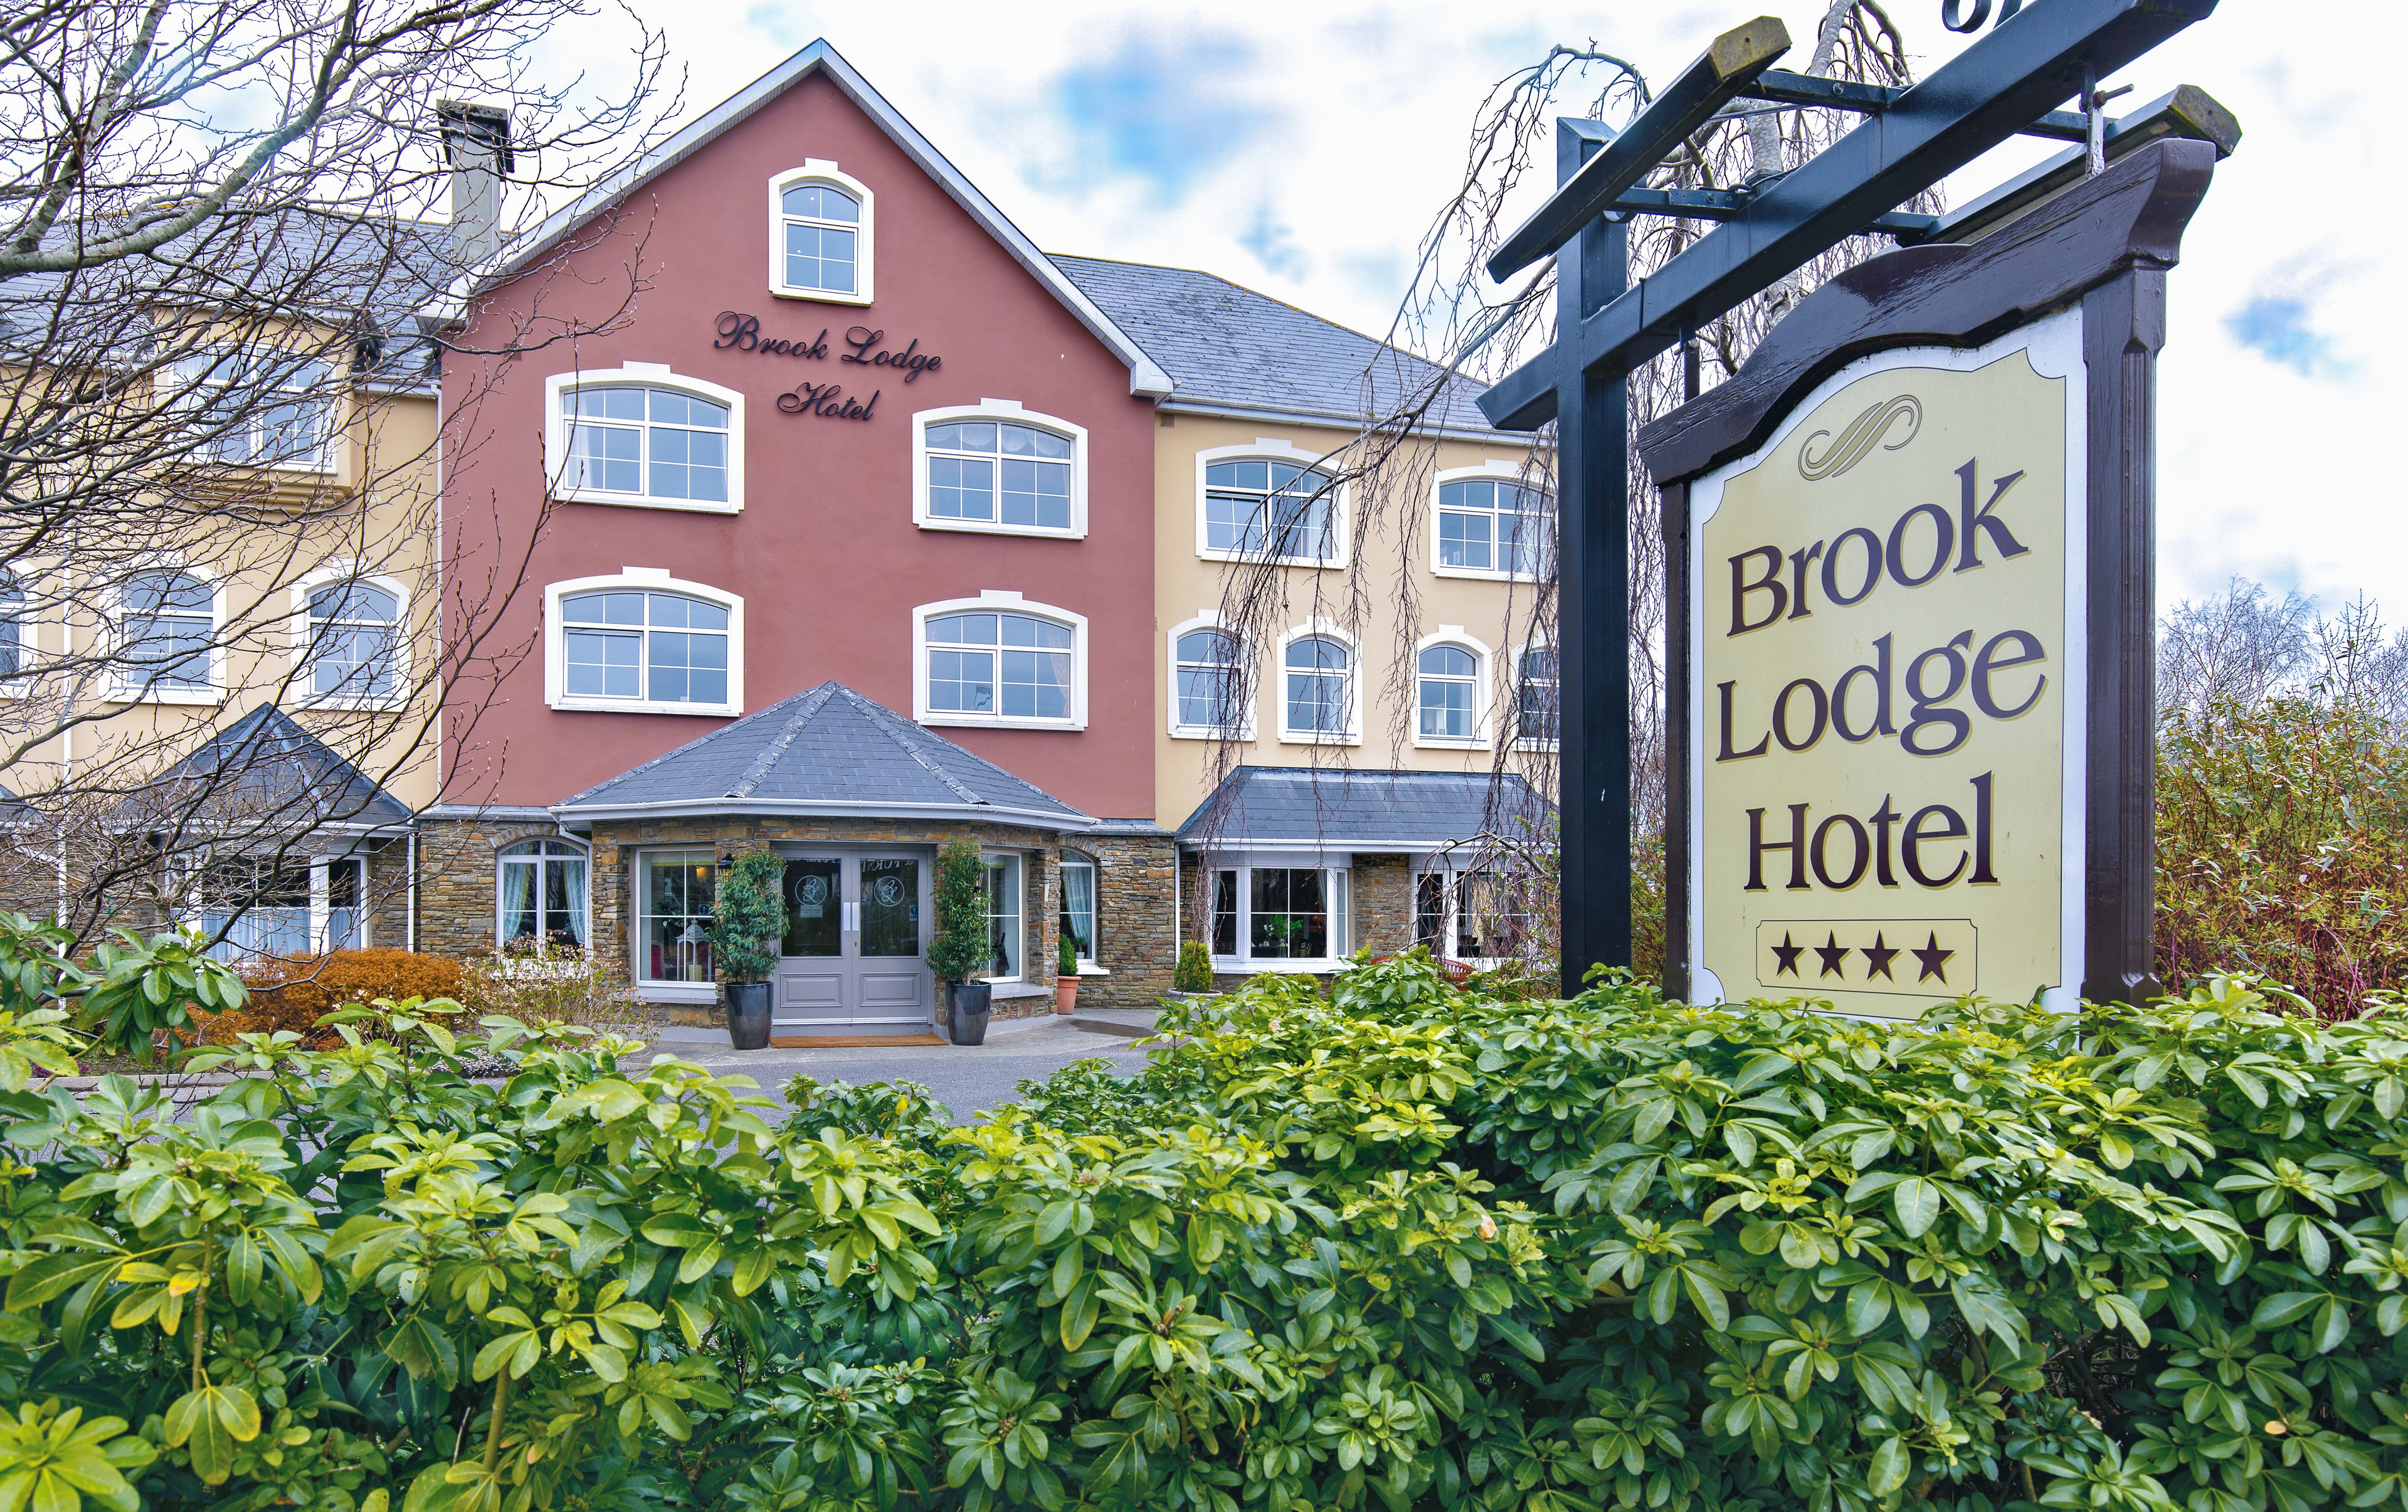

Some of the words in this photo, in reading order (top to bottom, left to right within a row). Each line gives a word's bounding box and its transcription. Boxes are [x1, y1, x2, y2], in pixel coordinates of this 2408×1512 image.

[714, 310, 828, 359] Brook
[841, 326, 941, 383] Lodge
[777, 381, 880, 420] Hotel
[1726, 456, 2032, 638] Brook
[1716, 628, 2049, 763] Lodge
[1744, 769, 2001, 892] Hotel
